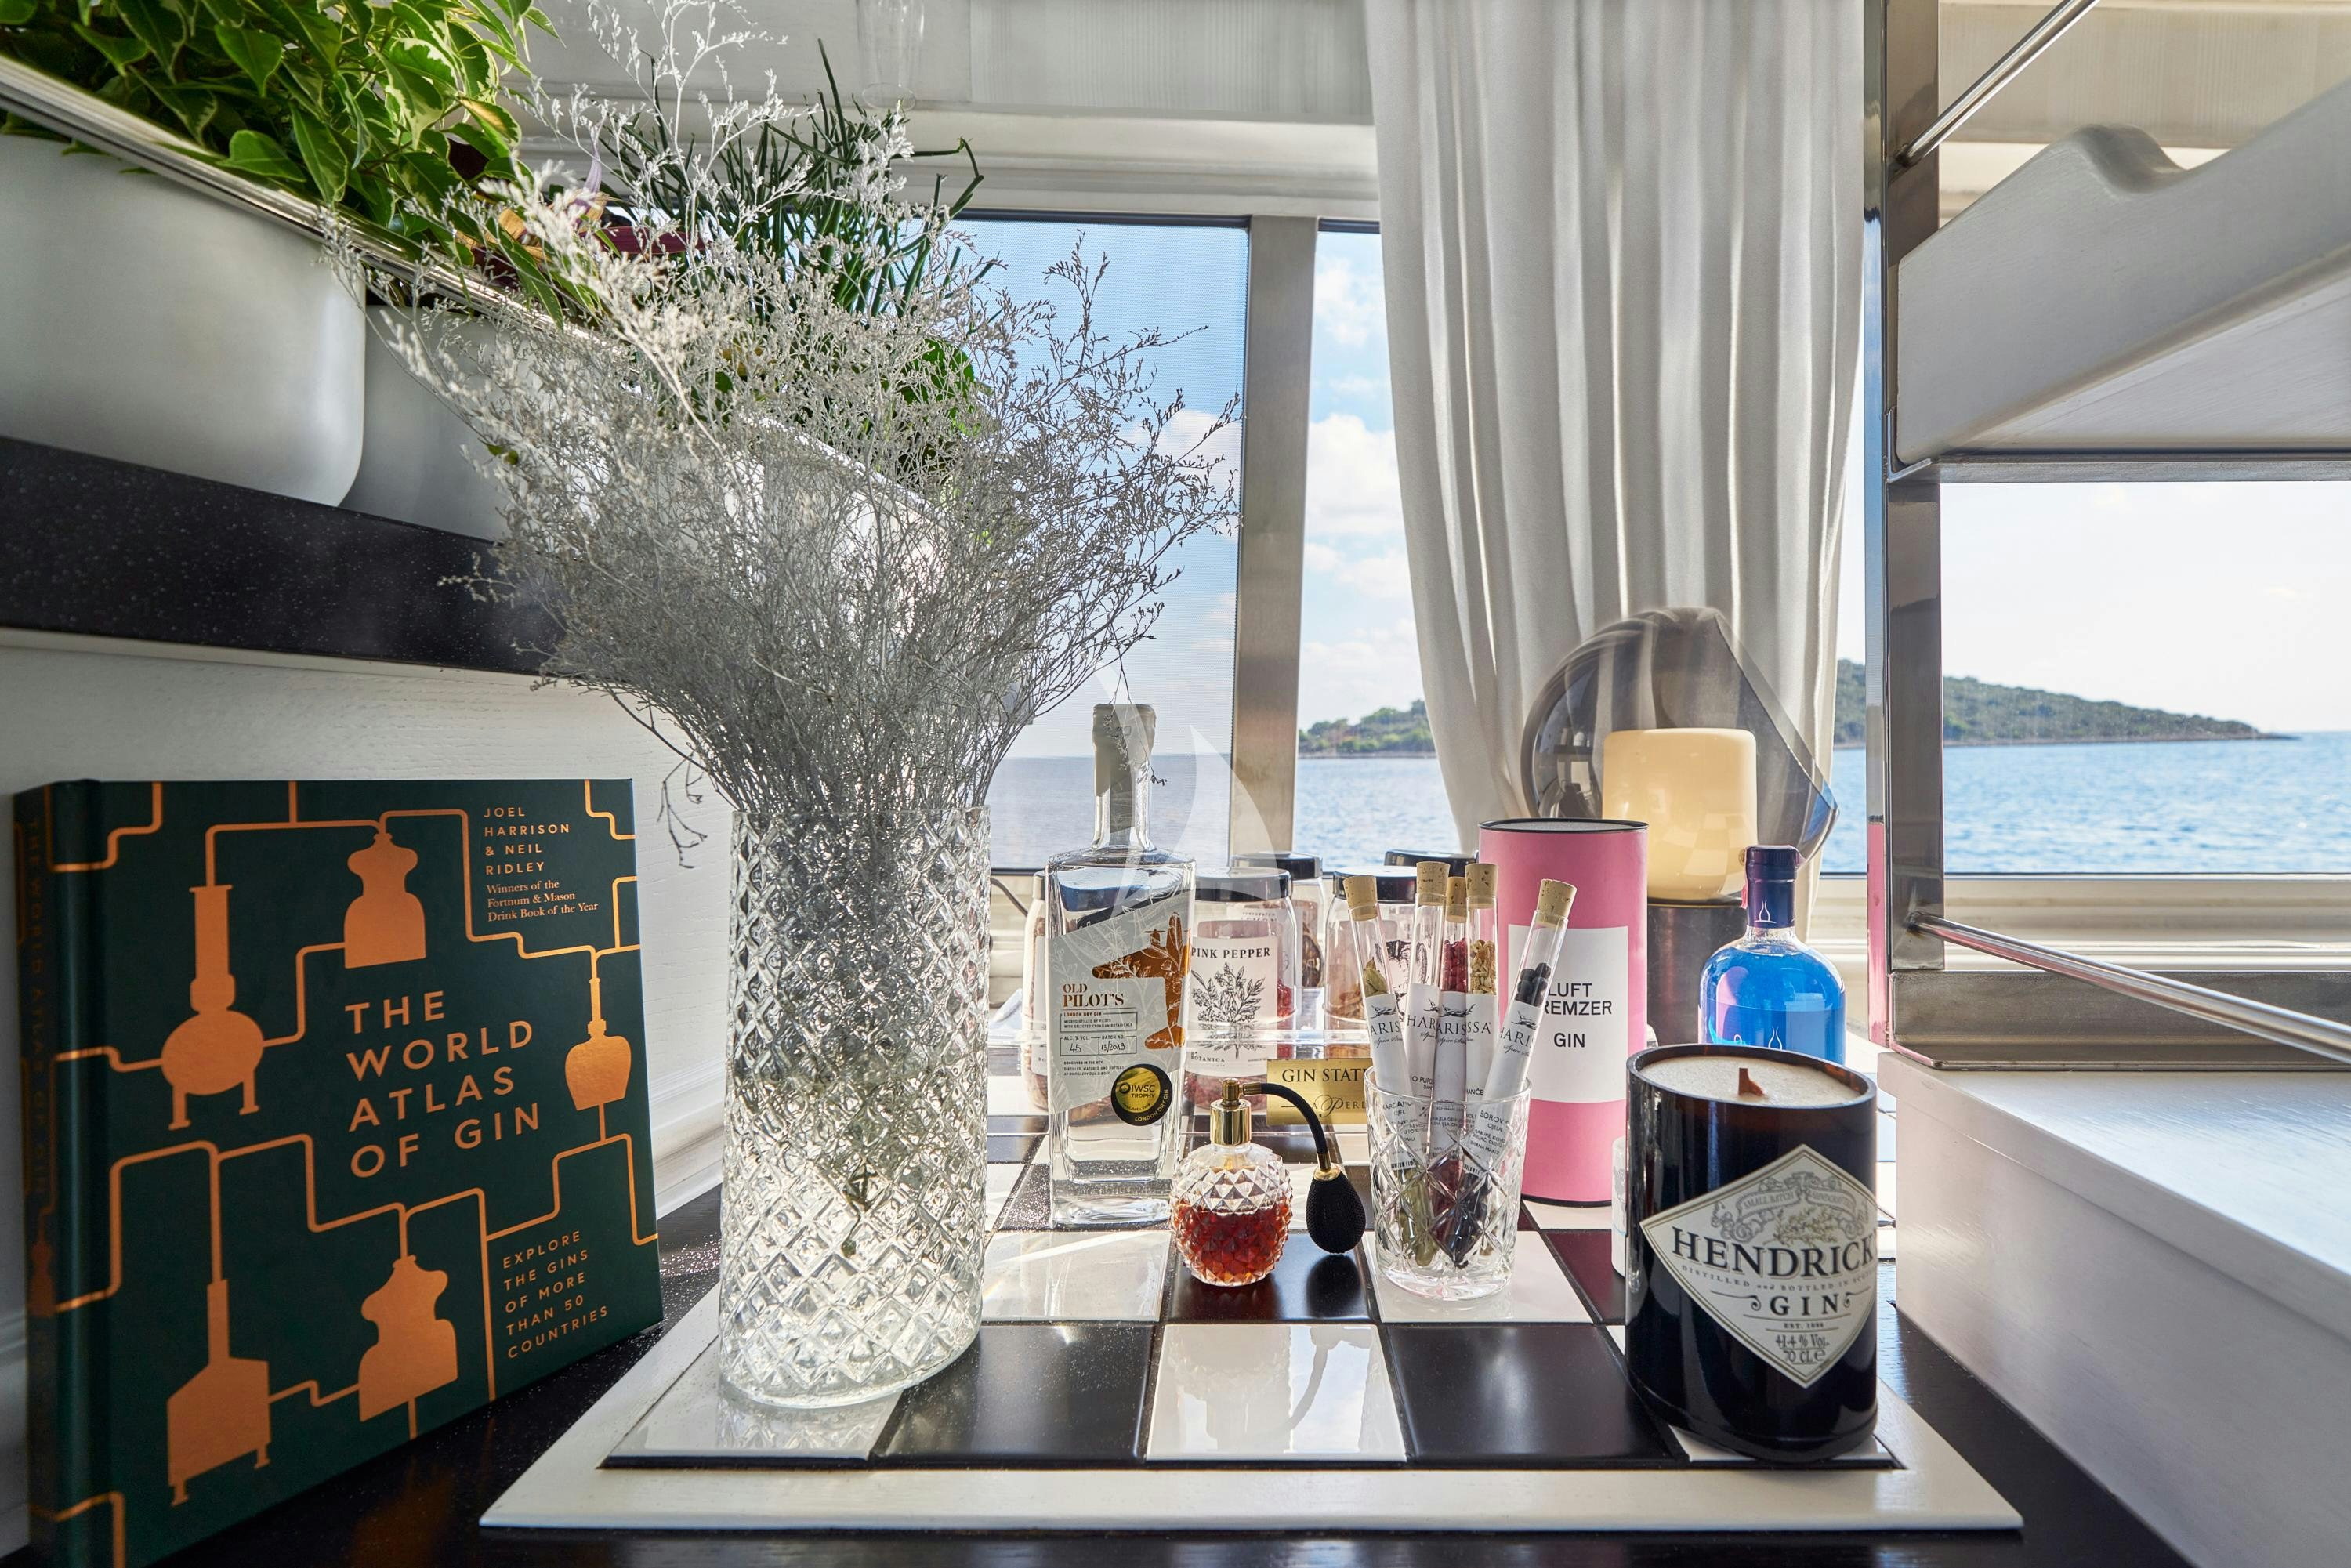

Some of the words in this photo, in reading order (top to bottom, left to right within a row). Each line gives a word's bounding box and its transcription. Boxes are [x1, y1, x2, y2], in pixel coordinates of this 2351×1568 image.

[484, 807, 525, 818] JOEL
[484, 824, 570, 837] HARRISON
[485, 846, 494, 856] &
[505, 844, 542, 855] NEIL
[486, 862, 545, 875] RIDLEY
[487, 883, 528, 894] Winners
[531, 880, 542, 890] of
[545, 879, 560, 889] the
[487, 898, 530, 908] Fortnum
[533, 895, 542, 904] &
[544, 893, 575, 903] Mason
[488, 911, 517, 922] Drink
[520, 907, 545, 918] Book
[548, 905, 559, 915] of
[561, 904, 575, 914] the
[578, 902, 599, 911] Year
[1191, 947, 1218, 958] PINK
[1223, 947, 1270, 959] PEPPER
[1063, 983, 1088, 994] OLD
[1063, 993, 1124, 1008] PILOT'S
[345, 990, 444, 1034] THE
[1545, 1001, 1612, 1016] REMZER
[1407, 1015, 1436, 1030] HAR
[1553, 1032, 1586, 1048] GIN
[346, 1020, 533, 1081] WORLD
[1070, 1043, 1081, 1053] 45
[1282, 1069, 1316, 1082] GIN
[1322, 1068, 1366, 1082] STAT
[348, 1066, 514, 1132] ATLAS
[1315, 1095, 1367, 1118] PERL
[1135, 1111, 1158, 1121] LONDON
[1157, 1100, 1166, 1112] DRY
[350, 1133, 419, 1178] OF
[454, 1103, 539, 1150] GIN
[503, 1230, 580, 1269] EXPLORE
[504, 1269, 536, 1291] THE
[547, 1249, 588, 1273] GINS
[1681, 1265, 1750, 1287] DISTILLED
[1780, 1282, 1834, 1291] BOTTLED
[505, 1295, 527, 1313] OF
[539, 1272, 585, 1300] MORE
[1770, 1294, 1838, 1316] GIN
[506, 1306, 554, 1336] THAN
[564, 1295, 584, 1311] 50
[508, 1305, 608, 1358] COUNTRIES
[1799, 1334, 1809, 1347] %
[1783, 1349, 1796, 1363] 70
